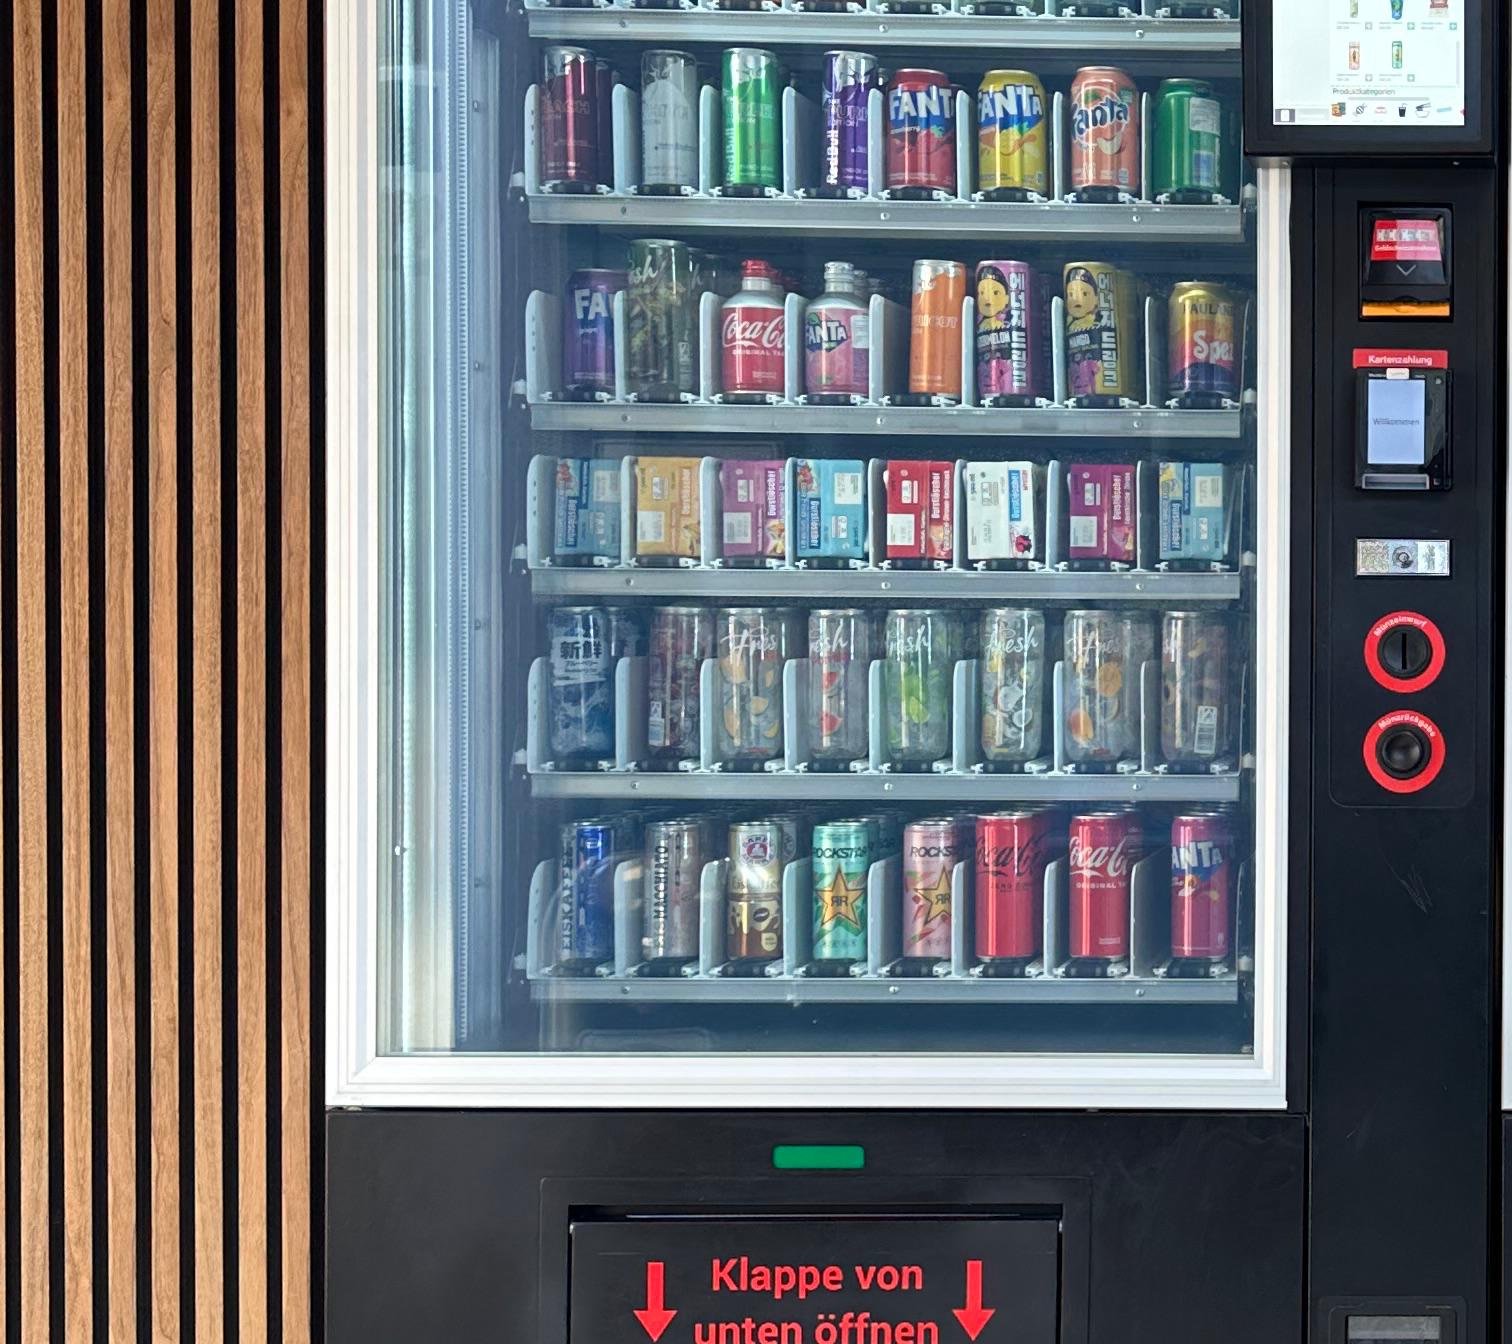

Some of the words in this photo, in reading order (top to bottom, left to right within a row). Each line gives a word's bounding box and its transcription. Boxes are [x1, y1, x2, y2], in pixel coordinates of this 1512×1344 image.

[806, 320, 847, 346] ANTA
[1368, 354, 1433, 366] Kartenzahlung
[909, 846, 952, 859] ROCKS
[1171, 841, 1223, 869] ANTA
[712, 1256, 844, 1300] Klappe
[855, 1265, 923, 1291] von
